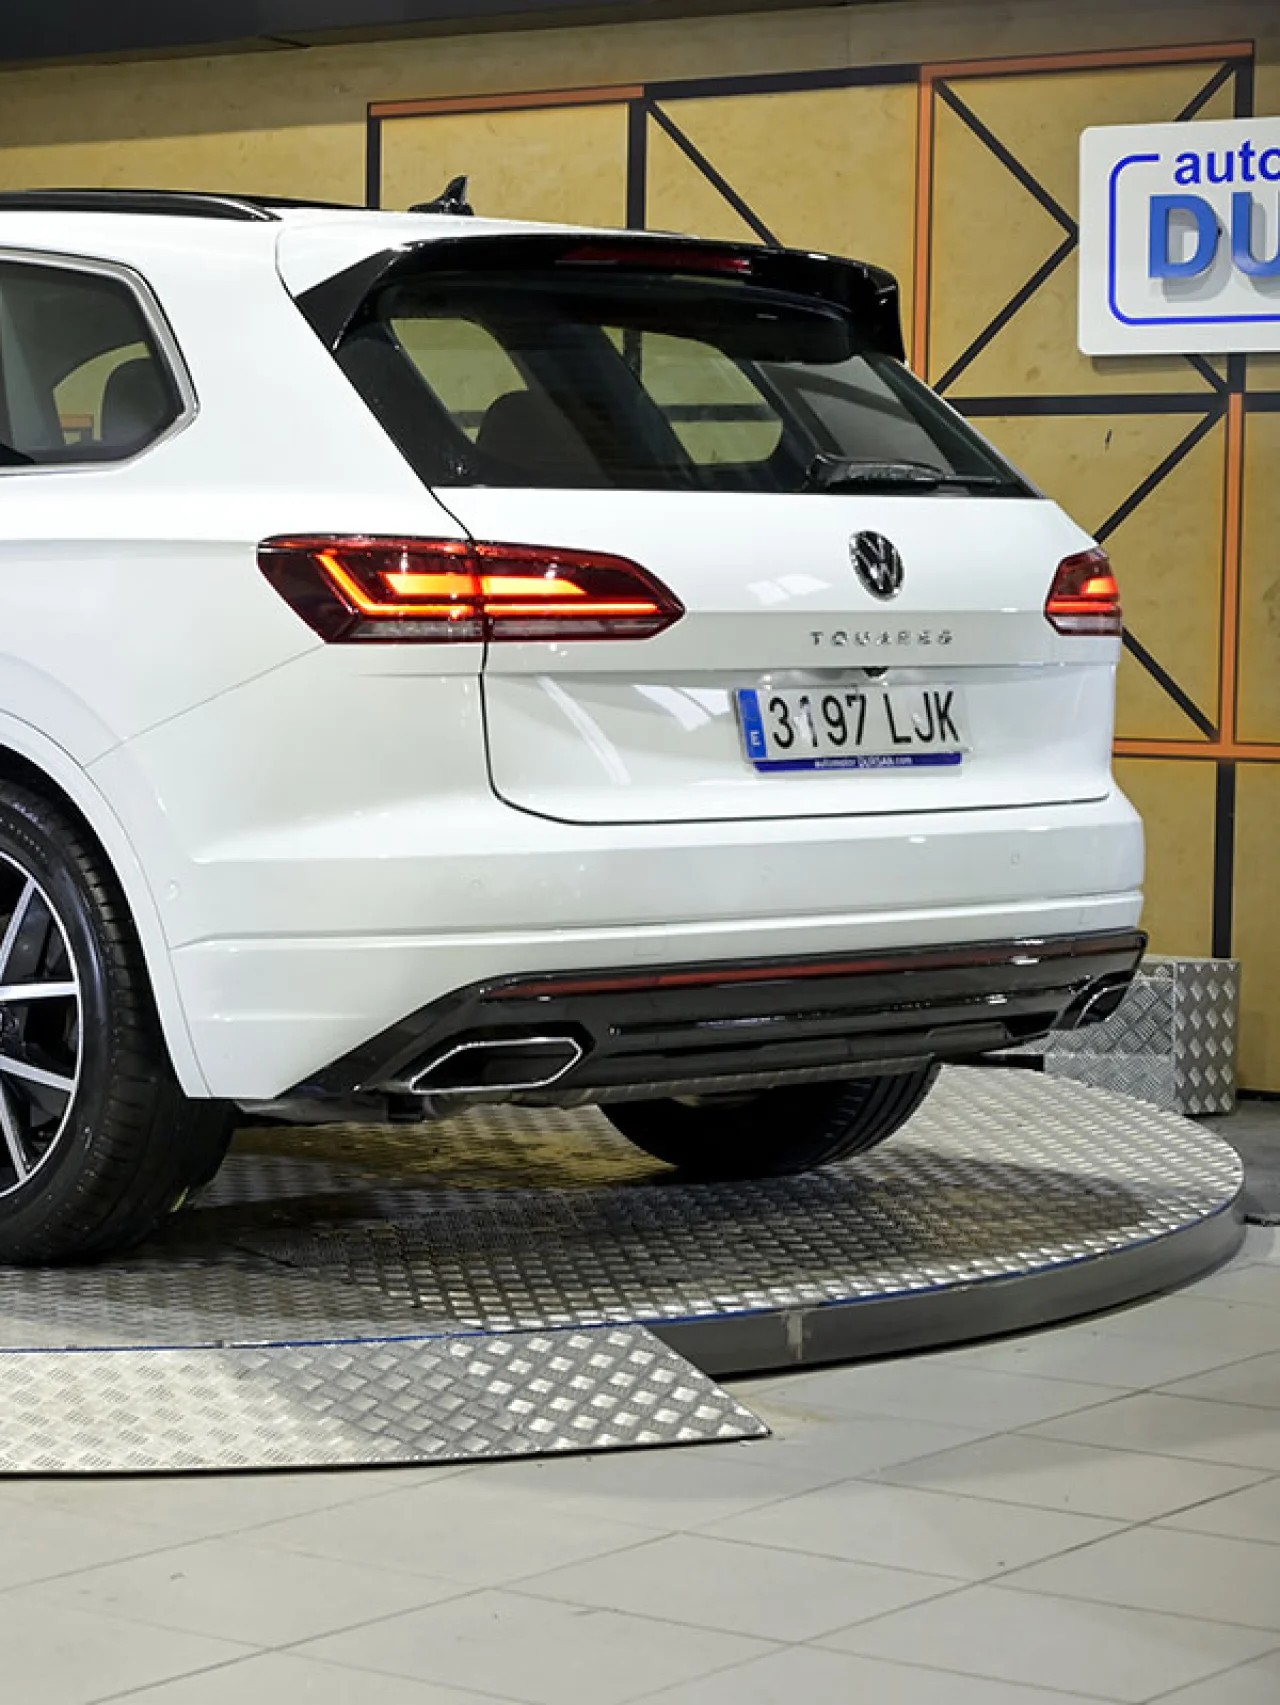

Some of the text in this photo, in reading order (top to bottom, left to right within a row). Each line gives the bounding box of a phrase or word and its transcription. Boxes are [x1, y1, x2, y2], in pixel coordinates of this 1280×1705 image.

[810, 630, 953, 647] TOUAREG
[769, 690, 959, 749] 3197 LJK
[750, 731, 761, 746] E
